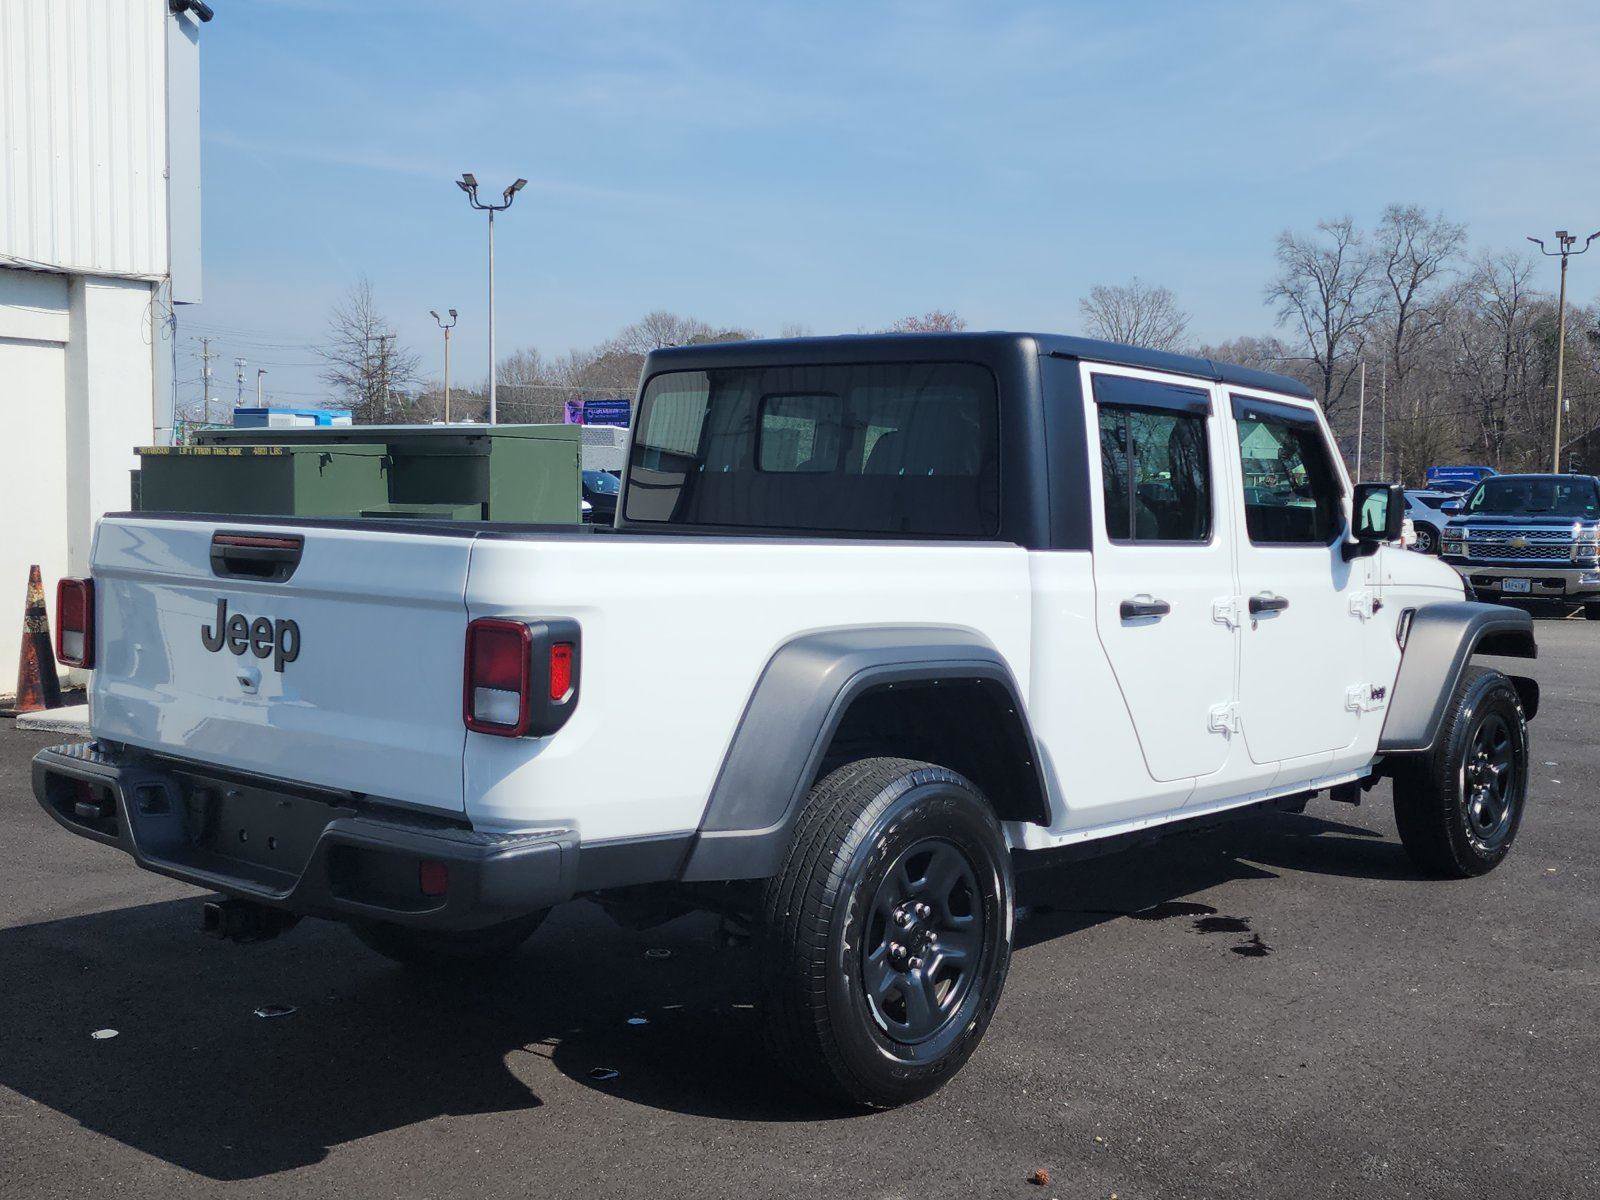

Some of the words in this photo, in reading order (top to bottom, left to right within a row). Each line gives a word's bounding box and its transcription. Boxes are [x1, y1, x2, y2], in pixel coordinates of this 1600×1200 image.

[194, 447, 211, 456] FROM
[212, 447, 228, 456] THIS
[228, 447, 243, 456] SIDE
[201, 598, 301, 673] Jeep
